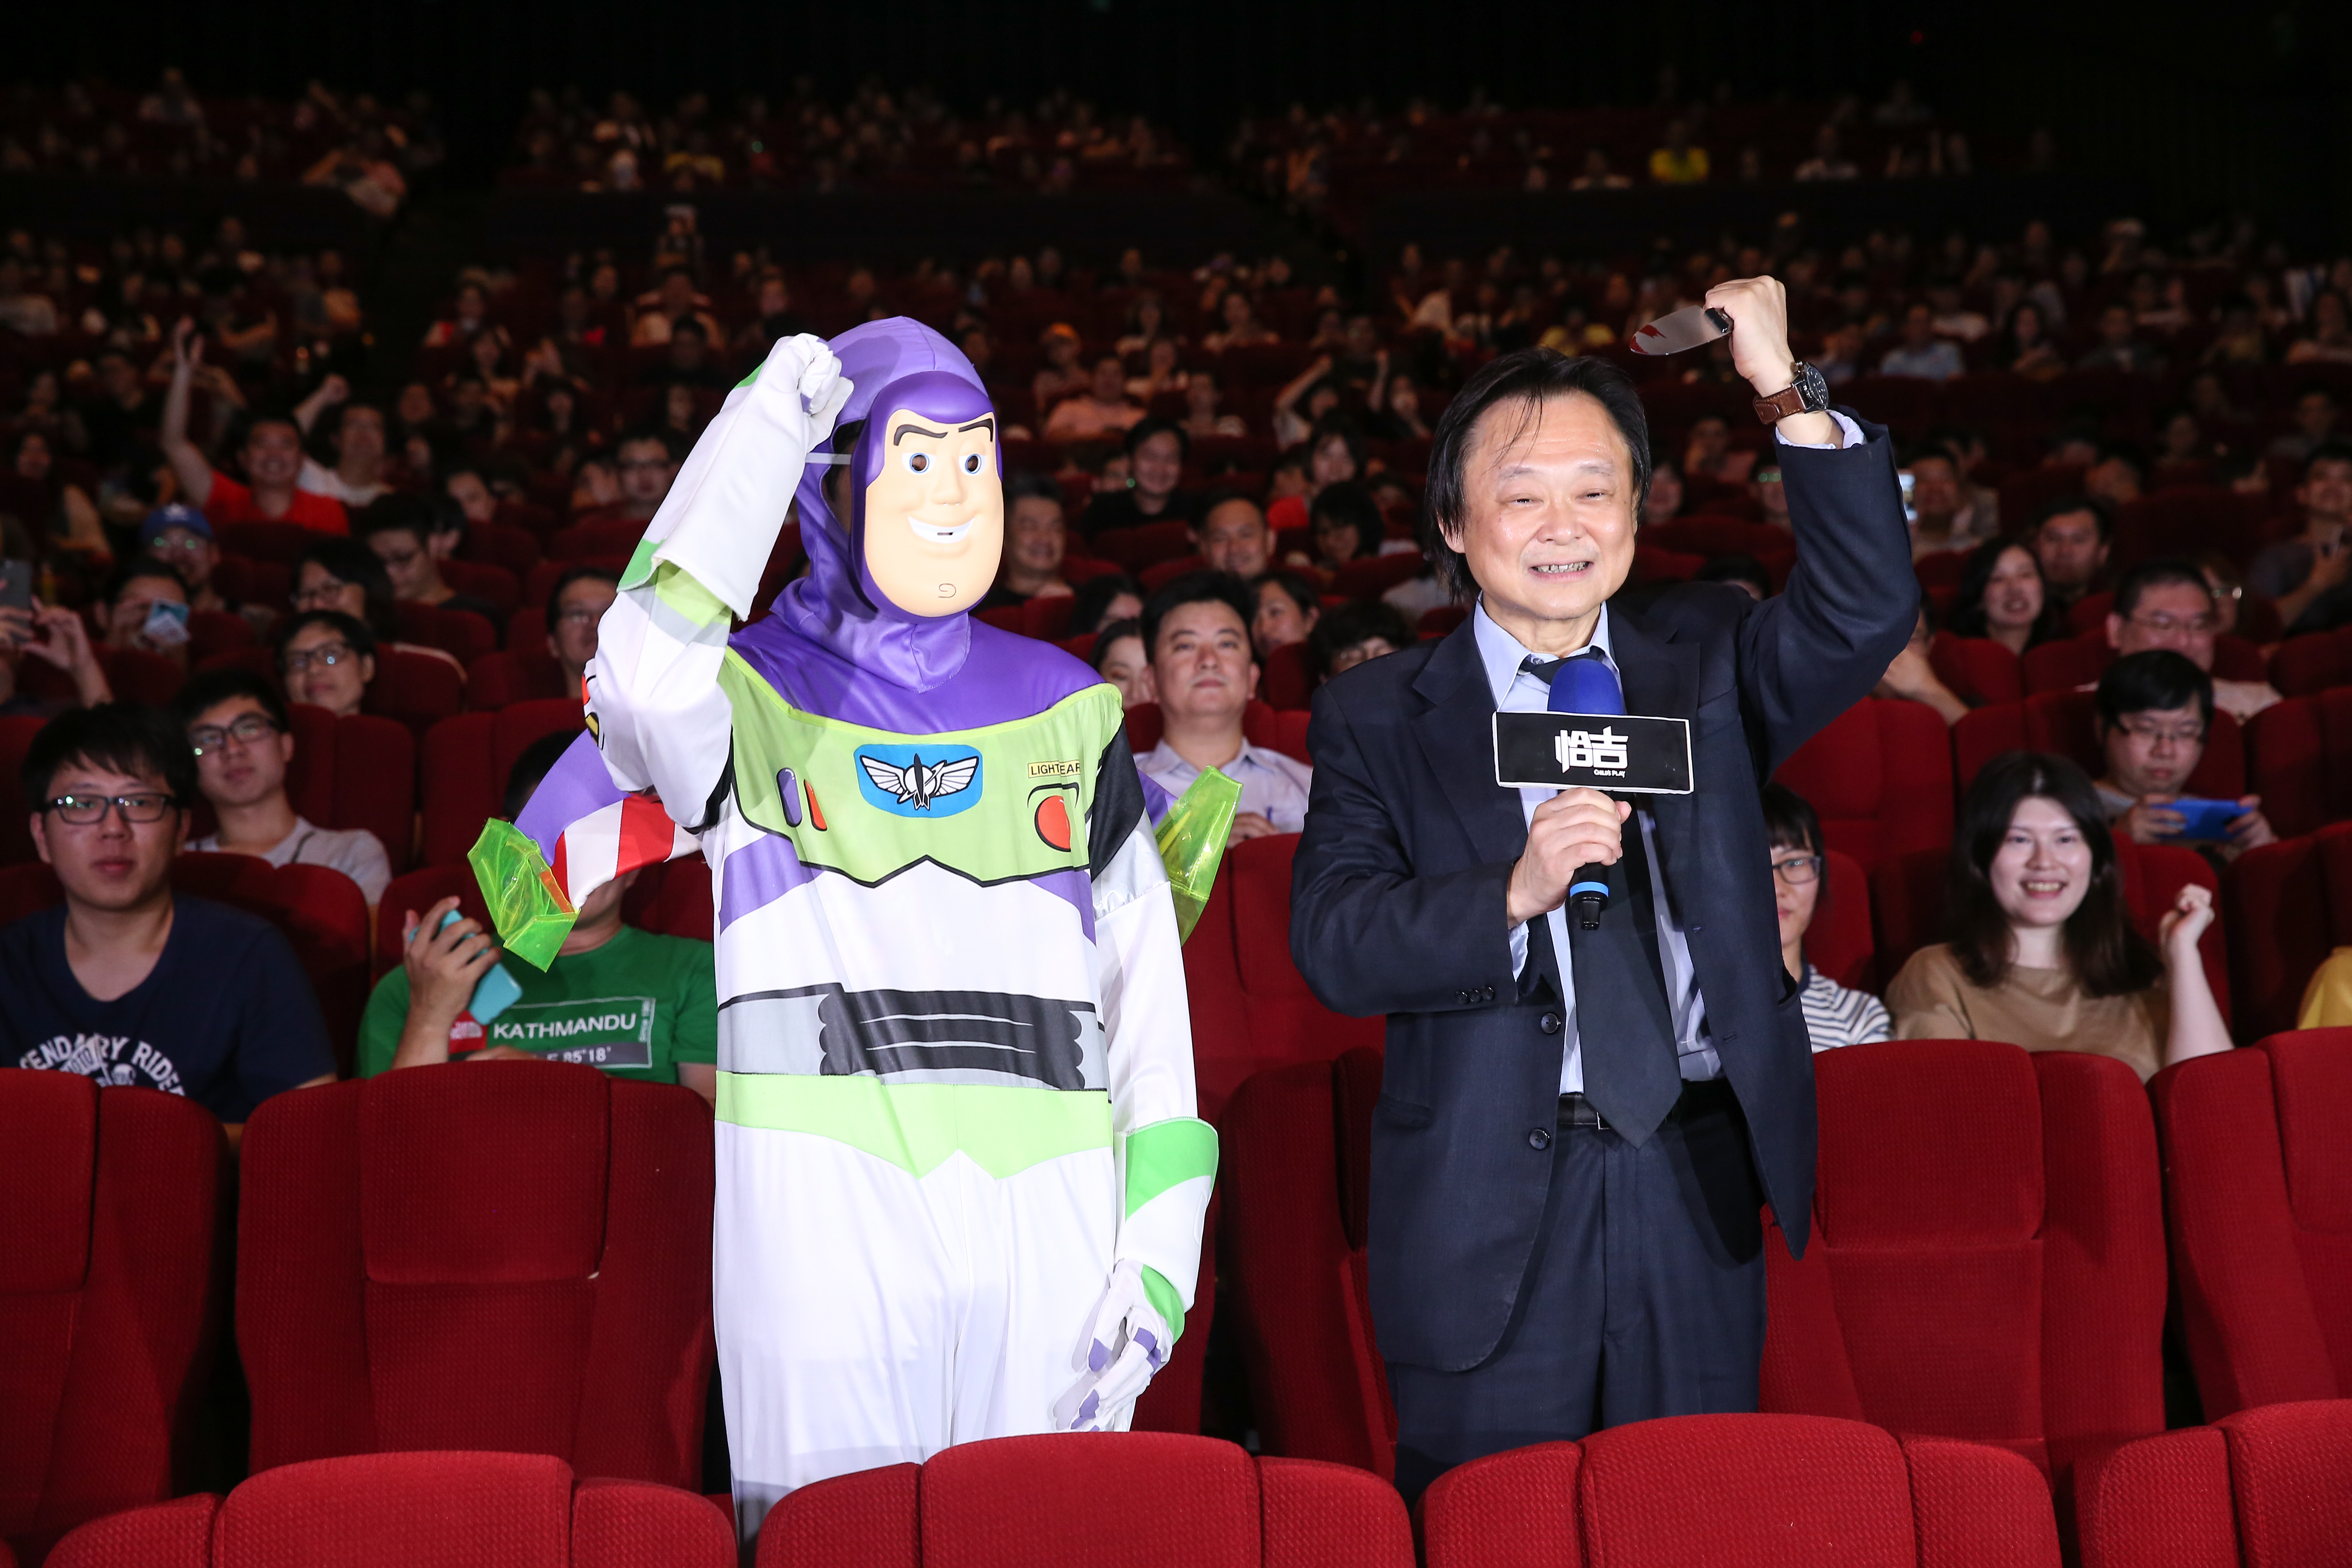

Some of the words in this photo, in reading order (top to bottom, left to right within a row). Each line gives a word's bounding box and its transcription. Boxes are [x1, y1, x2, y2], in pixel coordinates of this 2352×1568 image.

[1555, 725, 1628, 773] 恰吉
[1612, 770, 1626, 778] PLAY
[493, 1013, 637, 1039] KATHMANDU
